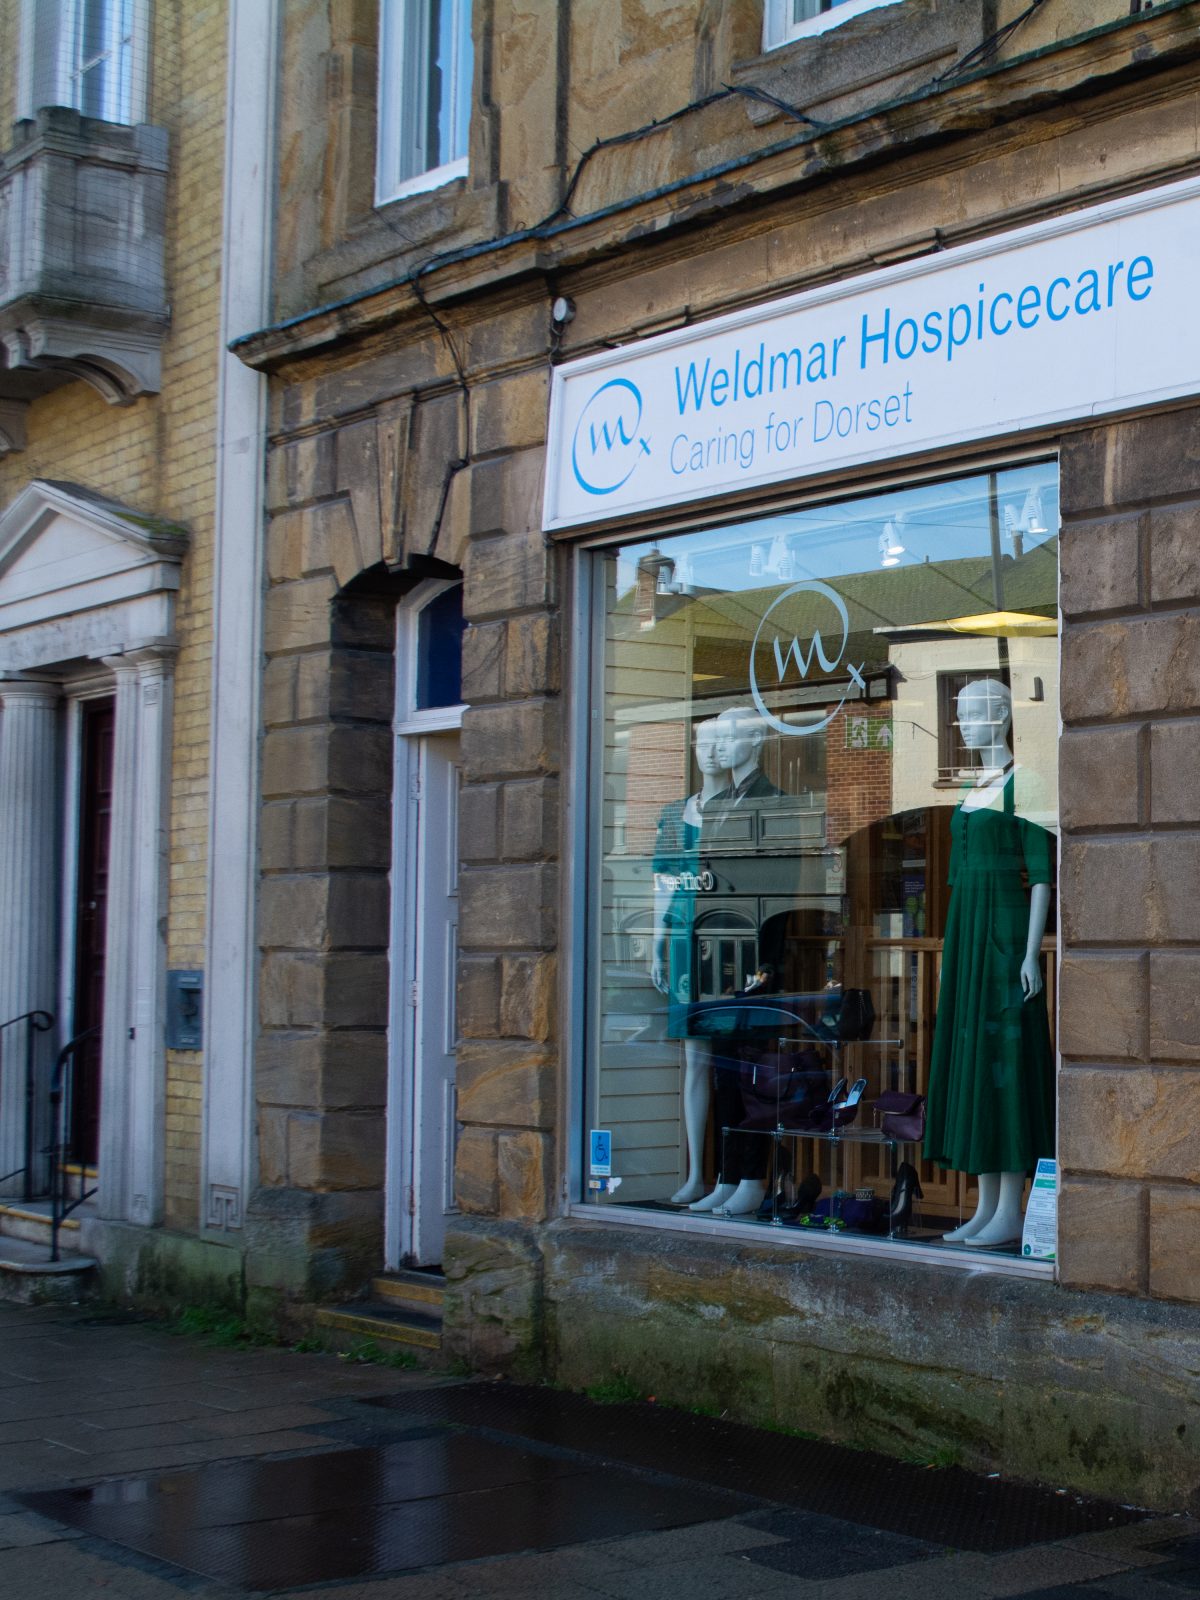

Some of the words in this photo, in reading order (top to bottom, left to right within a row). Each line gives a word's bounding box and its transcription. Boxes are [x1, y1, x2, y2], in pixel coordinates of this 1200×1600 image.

[674, 335, 847, 415] Weldmar
[860, 256, 1155, 369] Hospicecare
[670, 427, 755, 475] Caring
[765, 411, 804, 454] for
[813, 380, 914, 443] Dorset
